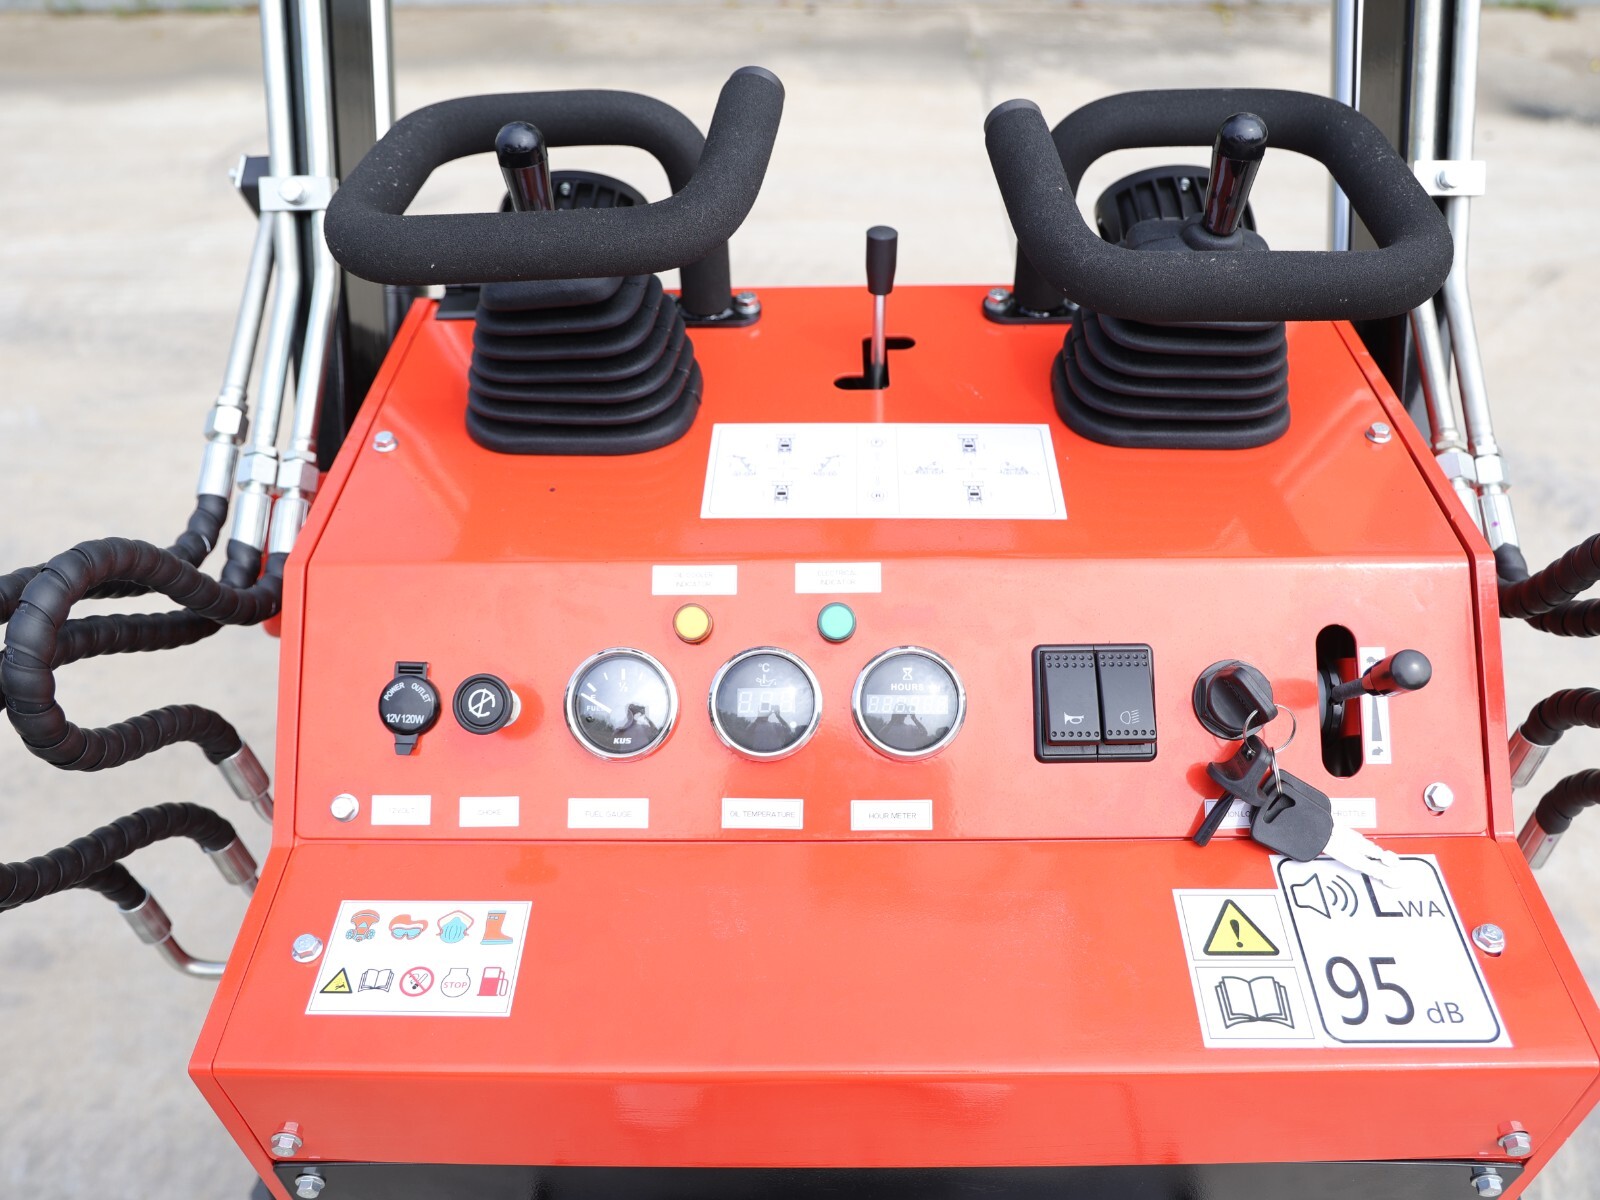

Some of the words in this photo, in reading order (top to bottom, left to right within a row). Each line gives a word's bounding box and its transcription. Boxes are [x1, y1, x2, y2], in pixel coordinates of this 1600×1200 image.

[890, 683, 924, 691] HOURS
[383, 681, 405, 701] POWER
[410, 682, 431, 703] OUTLET
[386, 713, 401, 723] 12V
[401, 714, 424, 724] 120W
[585, 810, 603, 818] FUEL
[605, 810, 632, 818] GAUGE
[729, 810, 740, 818] OIL
[743, 810, 796, 818] TEMPERATURE
[443, 981, 468, 989] STOP
[1325, 956, 1415, 1025] 95
[1426, 1001, 1464, 1024] dB
